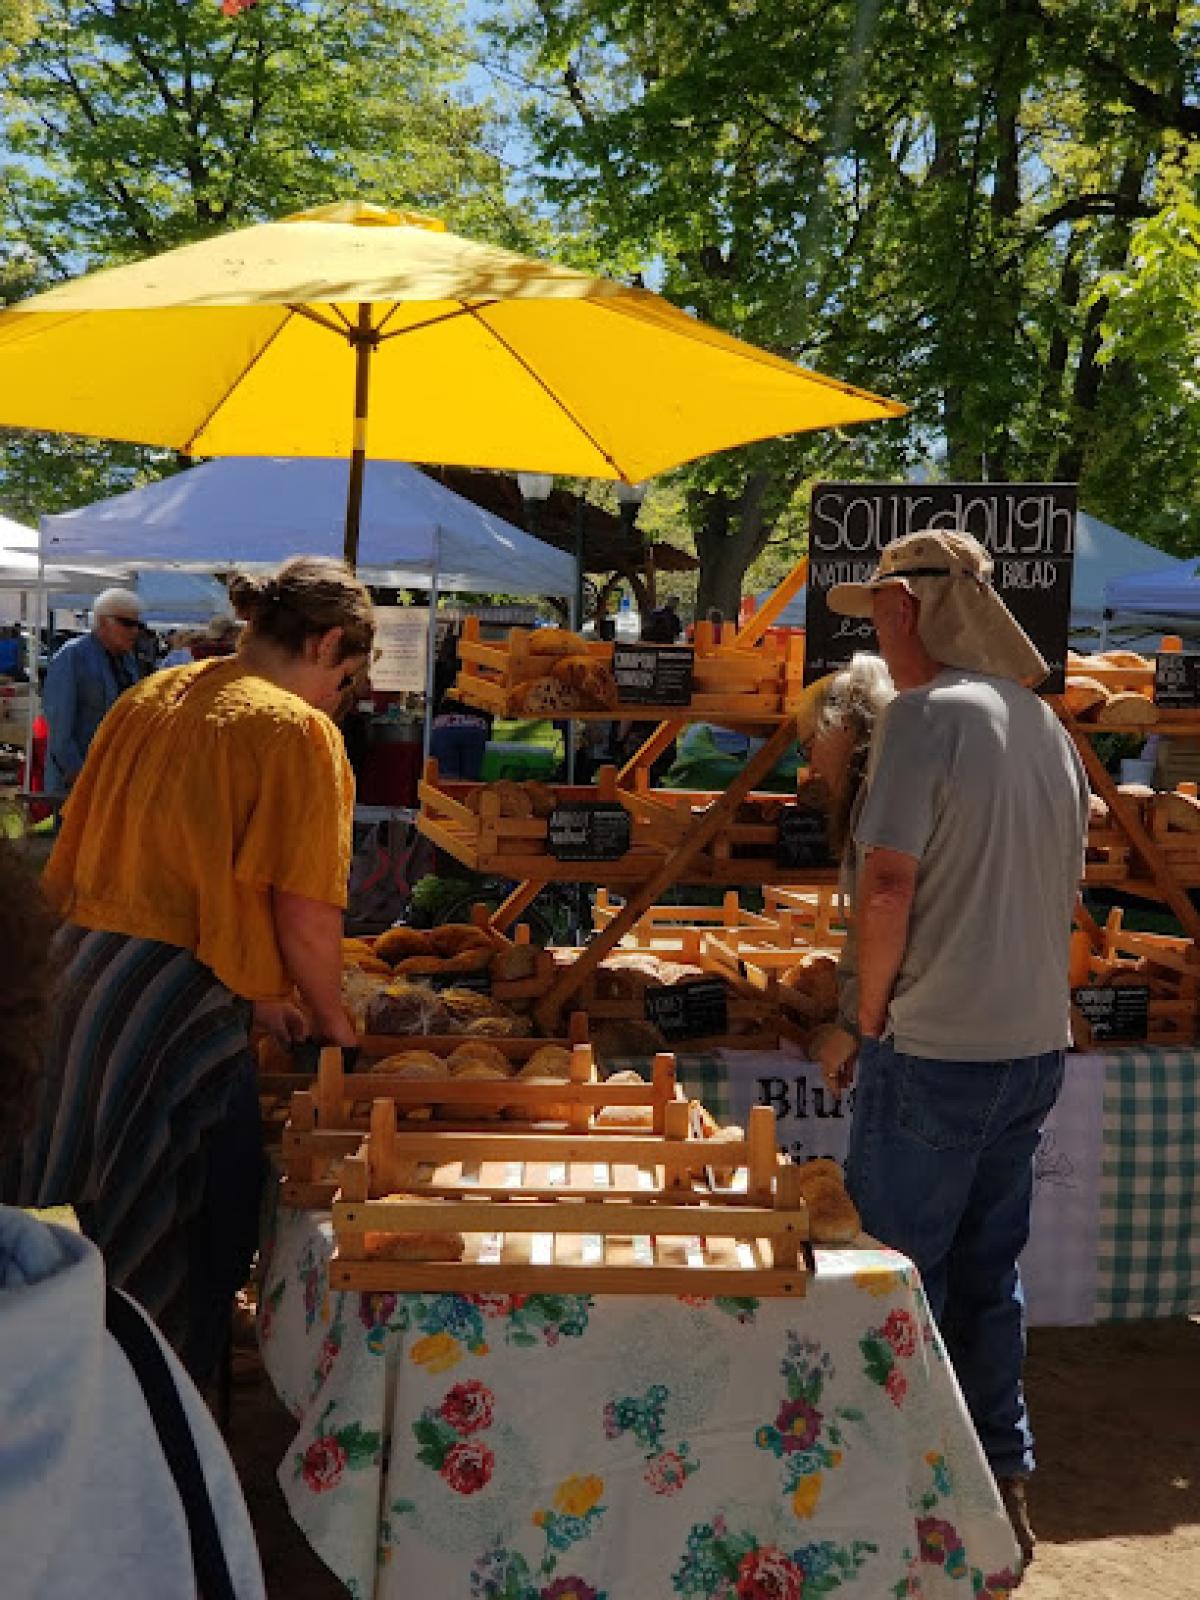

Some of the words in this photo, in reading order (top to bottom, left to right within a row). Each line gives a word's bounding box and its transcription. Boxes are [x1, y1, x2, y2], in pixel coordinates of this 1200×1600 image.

[814, 493, 1074, 554] Sourdough
[1002, 561, 1057, 589] BREAD
[756, 1076, 857, 1120] Blu
